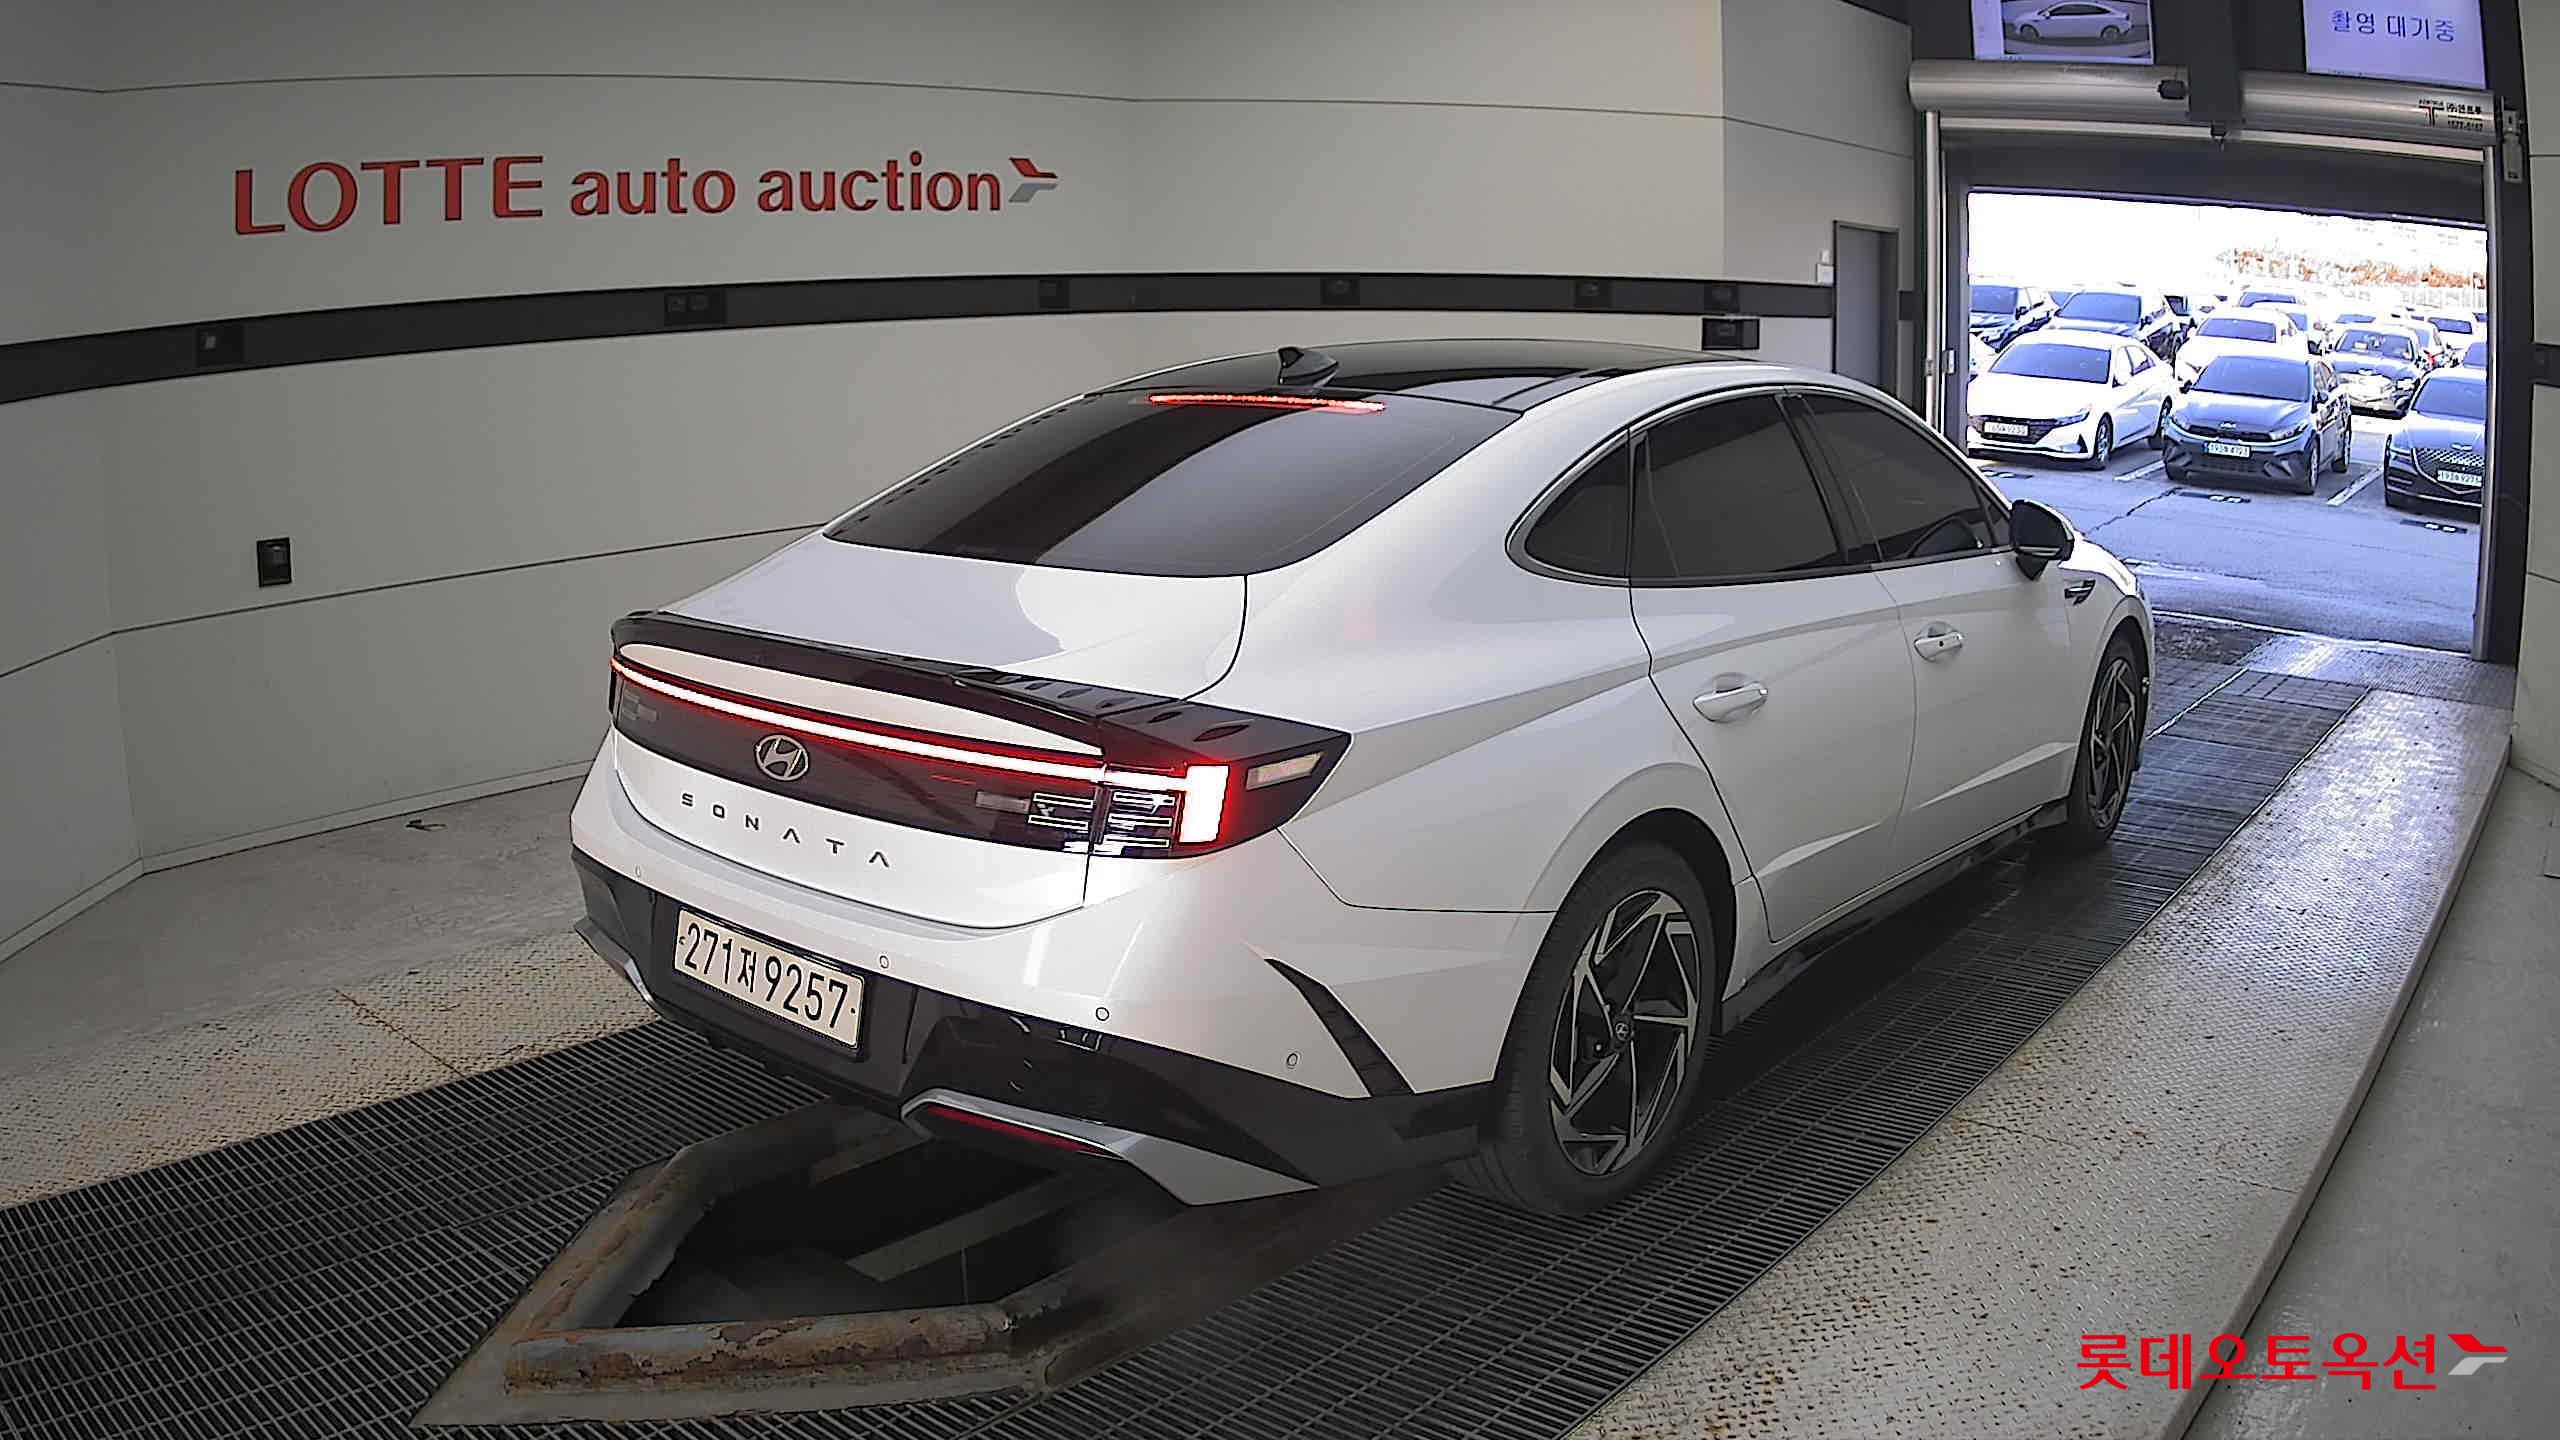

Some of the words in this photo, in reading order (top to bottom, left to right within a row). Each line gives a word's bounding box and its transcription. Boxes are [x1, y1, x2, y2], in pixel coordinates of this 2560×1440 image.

[2331, 9, 2375, 35] 촬영
[2386, 14, 2455, 43] 대기중
[235, 156, 544, 235] LOTTE
[570, 158, 737, 216] auto
[757, 151, 1002, 212] auction
[681, 792, 890, 868] SONATA
